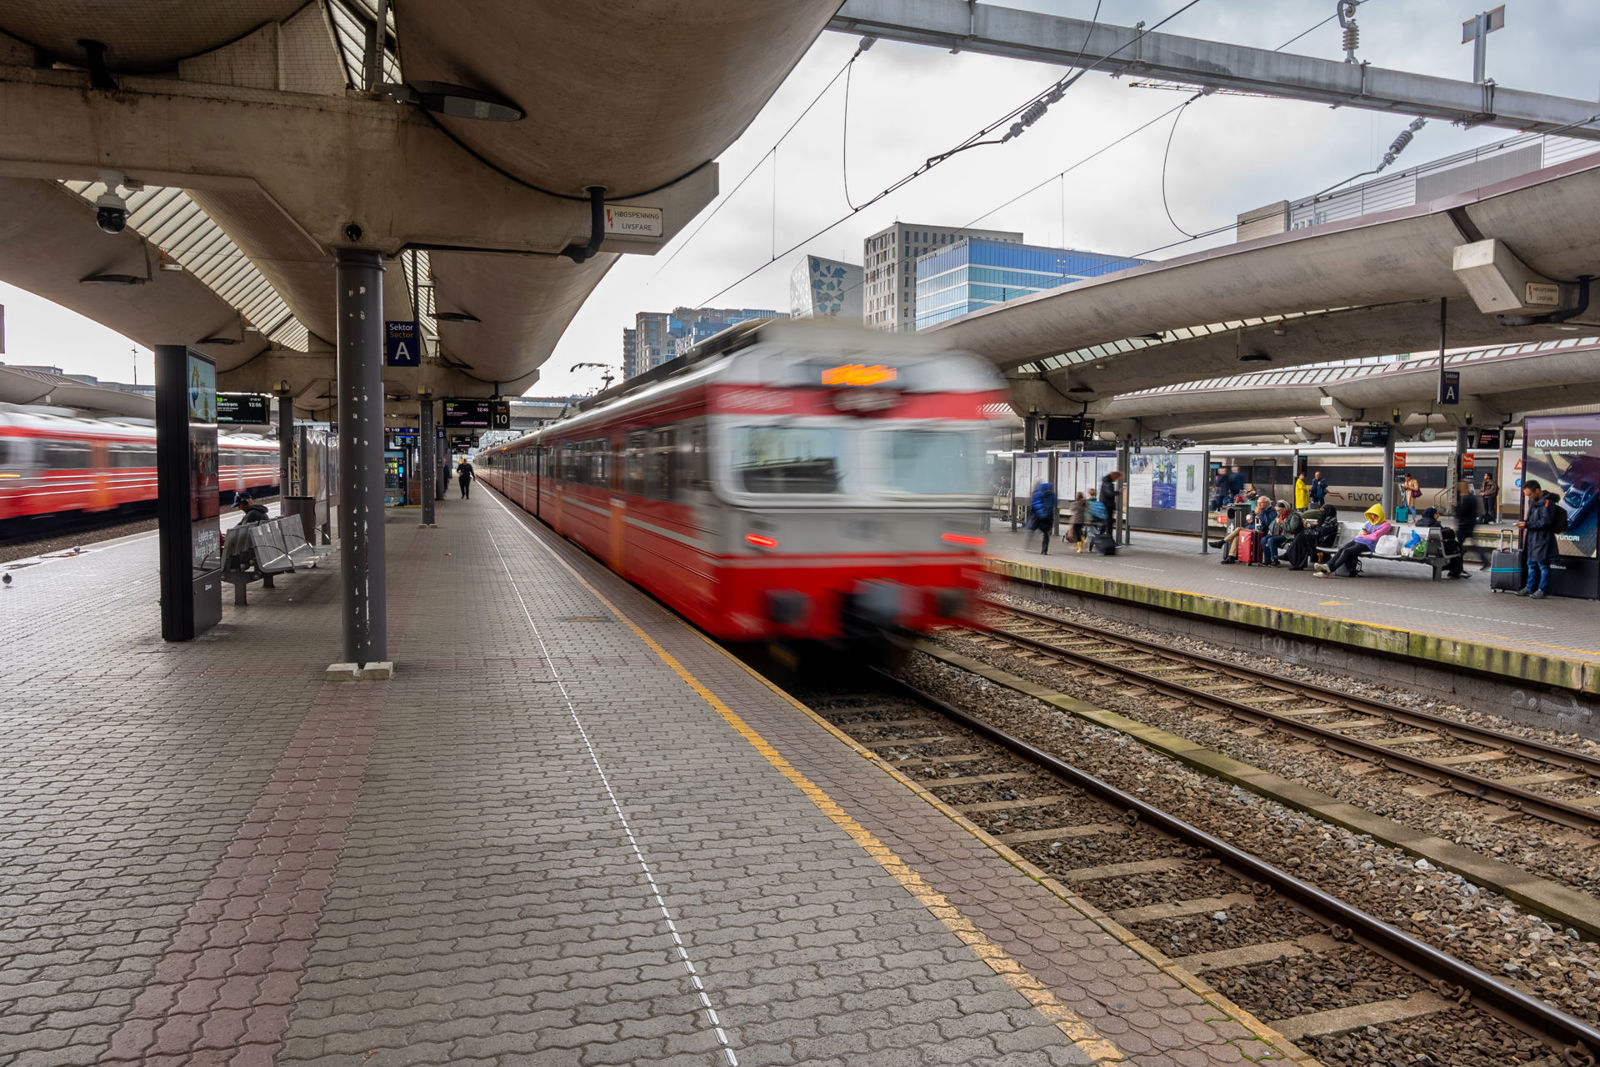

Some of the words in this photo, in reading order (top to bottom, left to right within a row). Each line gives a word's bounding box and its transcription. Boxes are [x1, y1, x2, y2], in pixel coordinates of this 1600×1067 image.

[615, 211, 660, 220] HØGSPENNING
[621, 223, 653, 231] LIVSFARE
[389, 323, 414, 331] Sektor
[394, 341, 411, 360] A
[1445, 385, 1455, 400] A
[495, 414, 508, 424] 10
[1083, 429, 1092, 438] 12
[1534, 439, 1560, 448] KONA
[1560, 438, 1593, 447] Electric
[1347, 492, 1382, 501] FLYTOG
